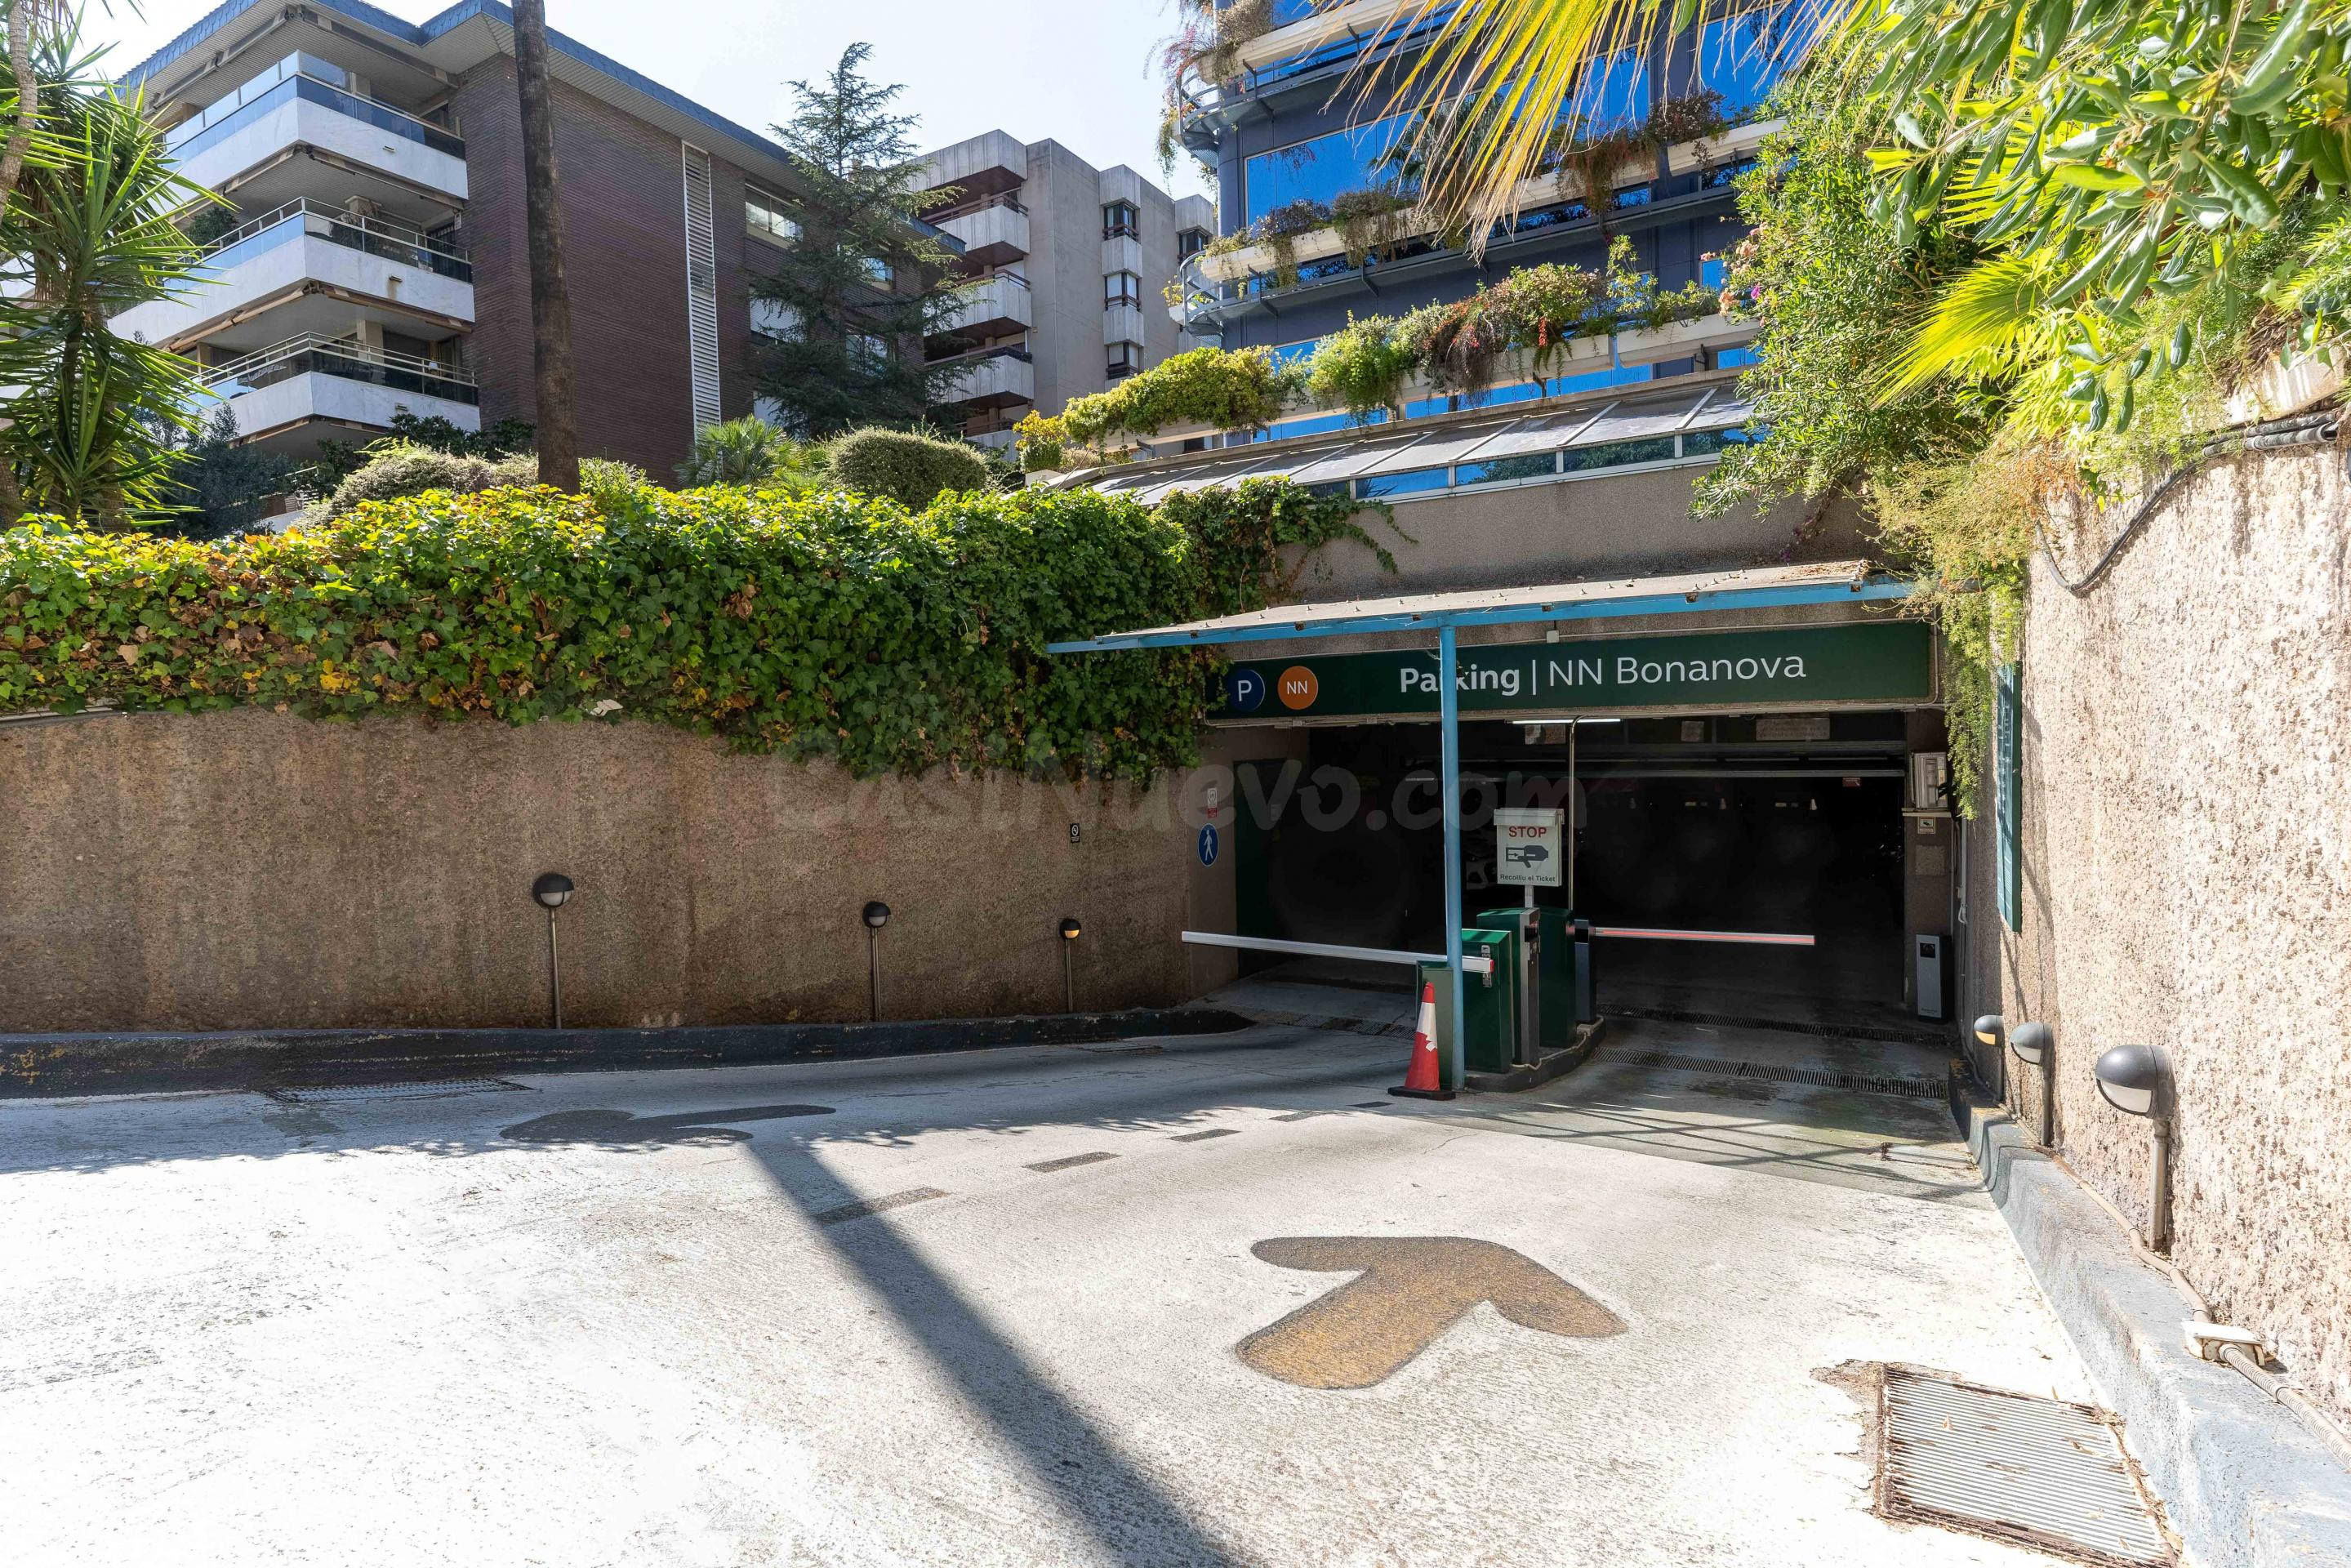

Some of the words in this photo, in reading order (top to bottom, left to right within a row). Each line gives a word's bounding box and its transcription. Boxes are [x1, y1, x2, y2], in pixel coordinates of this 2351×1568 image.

[1400, 663, 1521, 697] Paking
[1549, 658, 1603, 687] NN
[1616, 655, 1807, 684] Bonanova
[1237, 679, 1252, 702] P
[1286, 680, 1308, 695] NN
[1508, 826, 1547, 838] STOP
